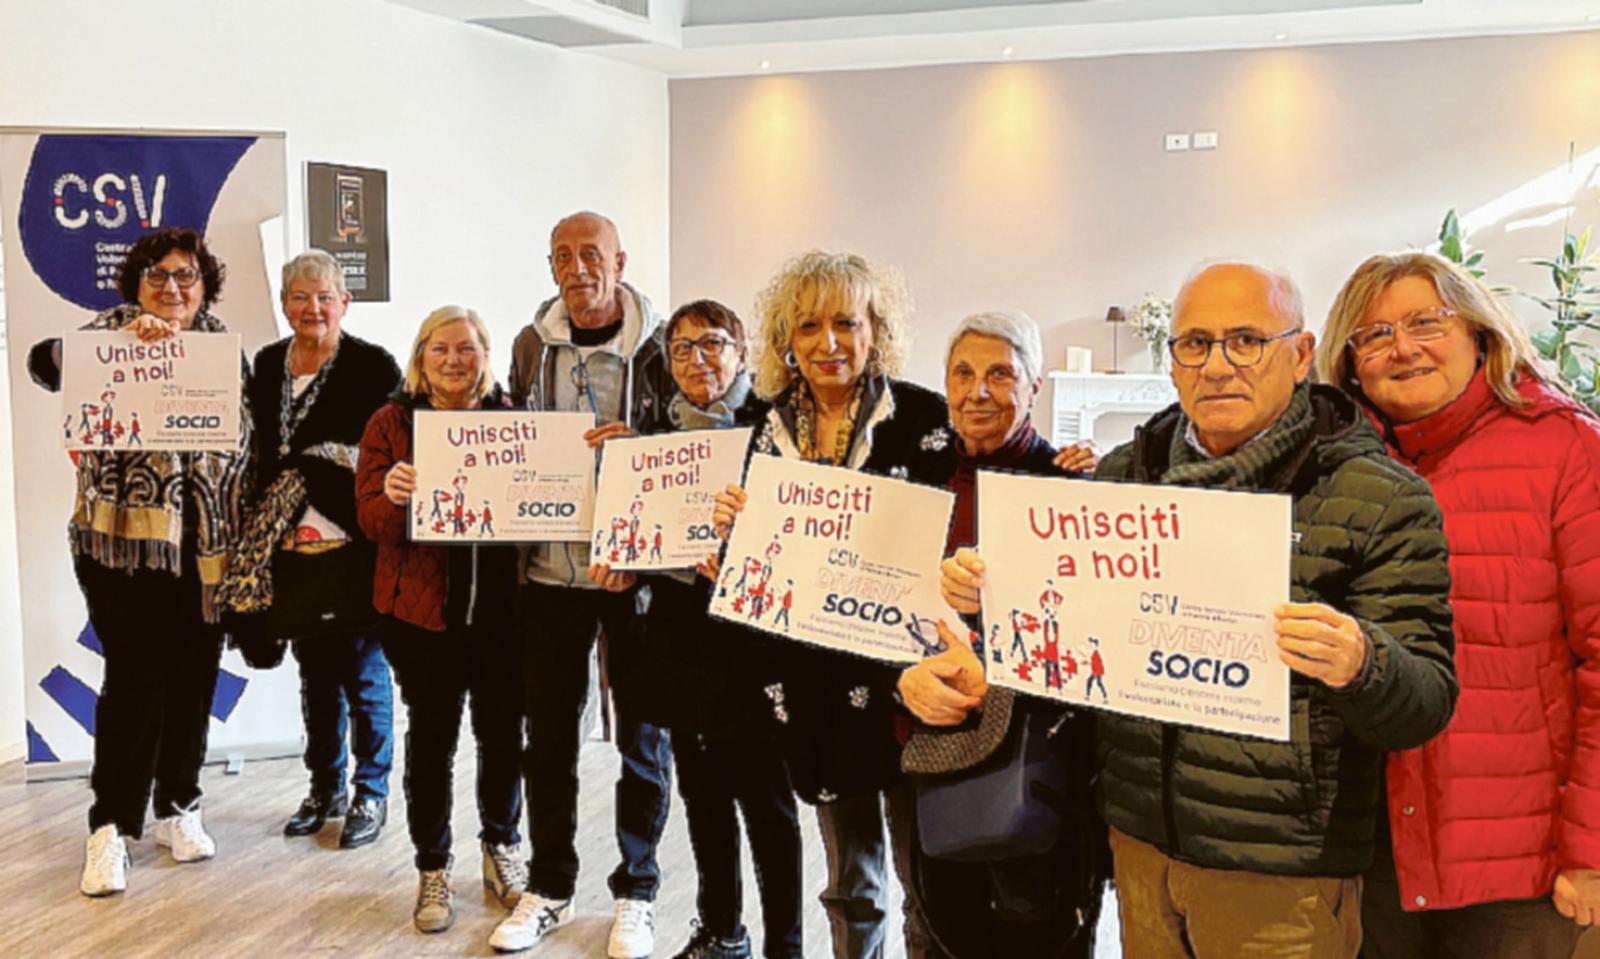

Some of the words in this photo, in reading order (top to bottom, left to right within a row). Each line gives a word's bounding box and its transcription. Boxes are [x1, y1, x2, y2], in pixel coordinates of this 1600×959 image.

[54, 173, 166, 229] CSV
[96, 340, 185, 364] Unisciti
[113, 369, 125, 383] a
[134, 361, 174, 383] noi!
[165, 415, 220, 429] SOCIO
[447, 420, 537, 447] Unisciti
[464, 453, 477, 467] a
[485, 443, 527, 466] noi!
[632, 439, 712, 472] Unisciti
[642, 478, 654, 492] a
[662, 464, 700, 489] noi!
[517, 501, 576, 517] SOCIO
[778, 481, 872, 513] Unisciti
[687, 524, 719, 541] SOC
[782, 516, 795, 533] a
[804, 513, 852, 540] noi!
[1029, 503, 1179, 540] Unisciti
[1057, 554, 1077, 577] a
[1092, 543, 1161, 580] noi!
[815, 567, 914, 603] DIVENT
[822, 593, 902, 626] SOCIO
[1140, 591, 1178, 616] CSV
[1129, 618, 1267, 663] DIVENTA
[1147, 650, 1250, 688] SOCIO
